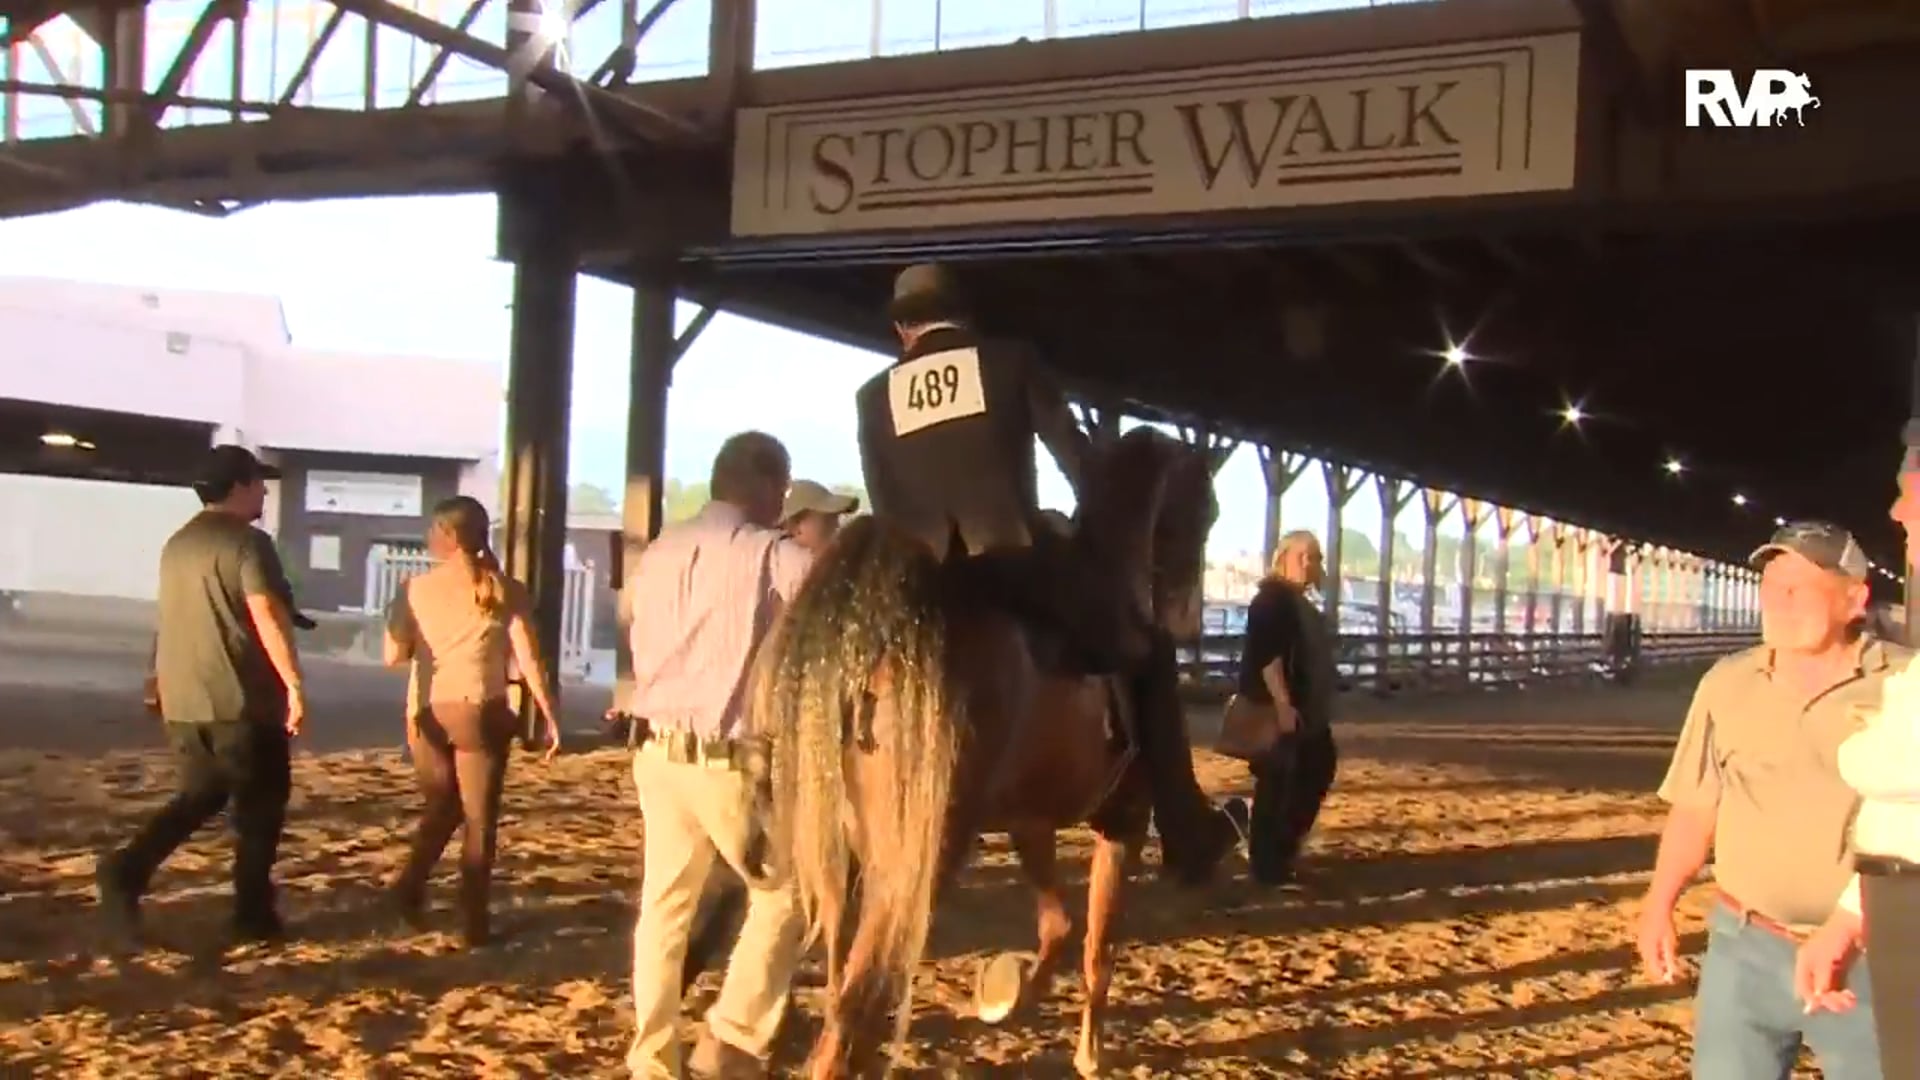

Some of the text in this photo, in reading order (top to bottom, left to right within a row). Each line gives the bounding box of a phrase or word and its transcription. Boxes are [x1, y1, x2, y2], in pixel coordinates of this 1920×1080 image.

[811, 81, 1461, 215] STOPHER WALK
[907, 364, 959, 412] 489
